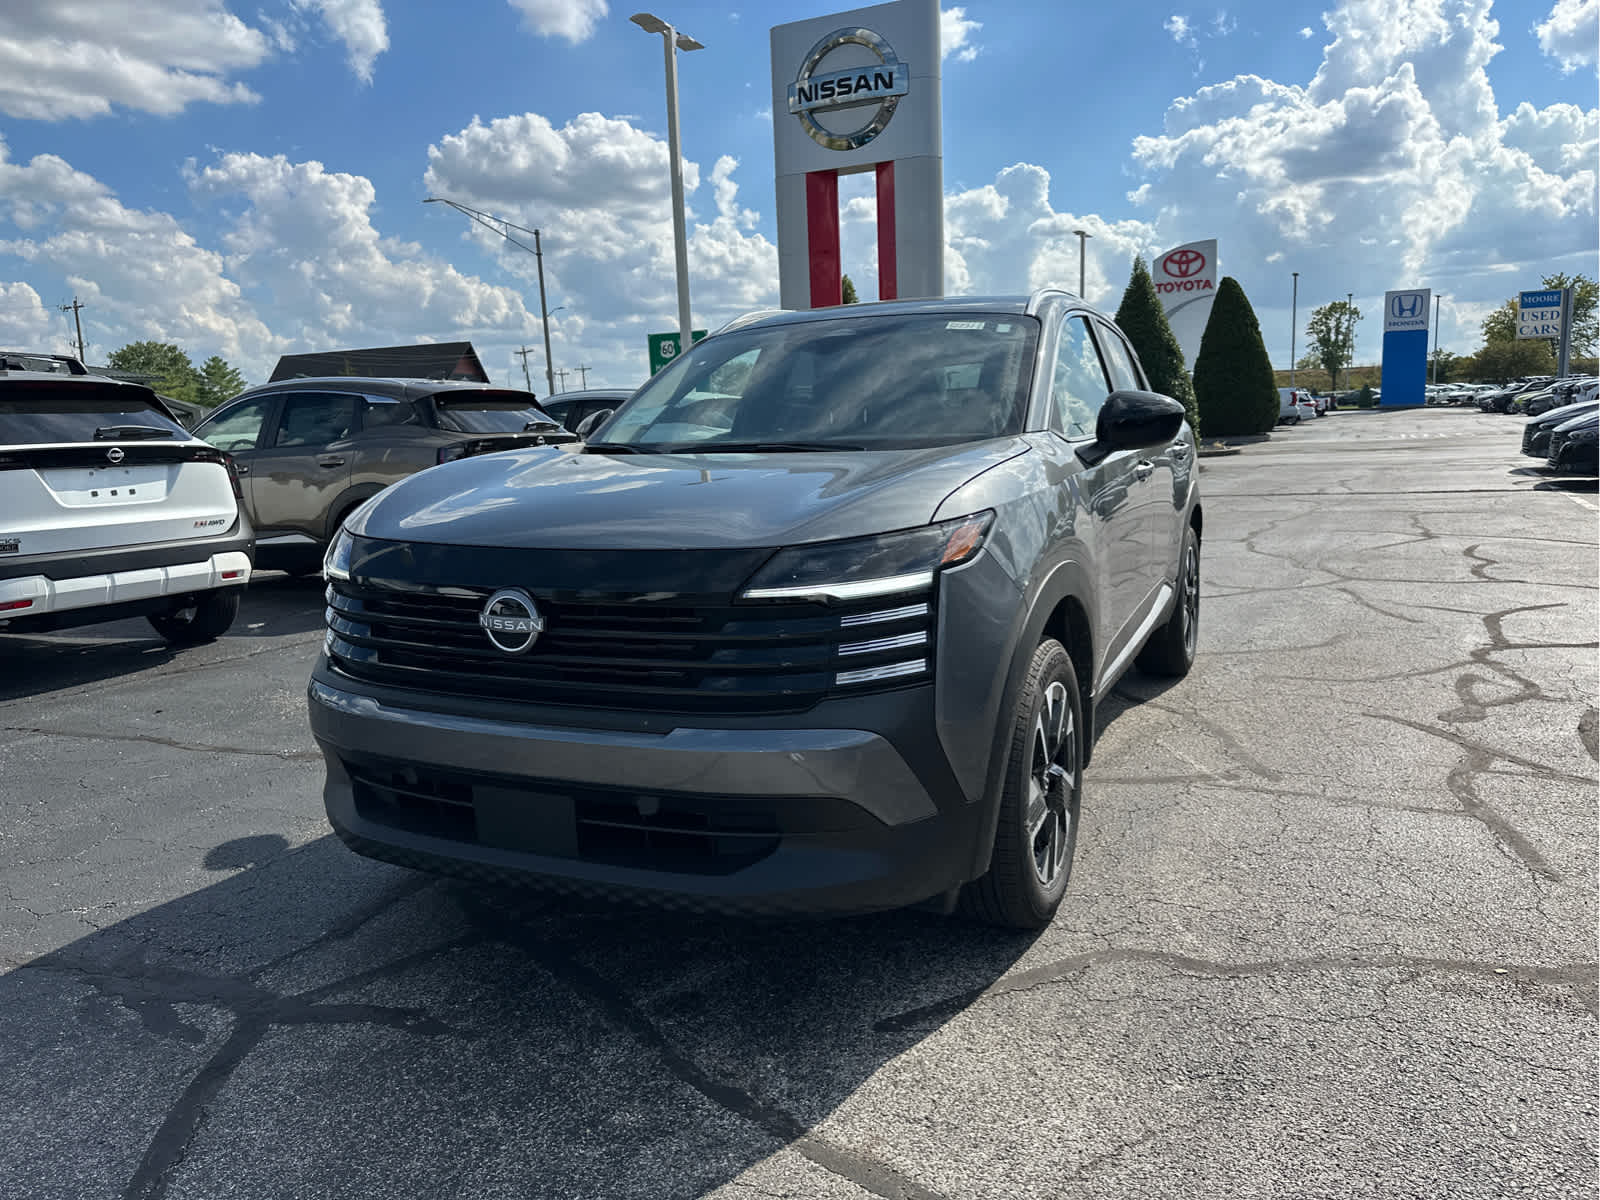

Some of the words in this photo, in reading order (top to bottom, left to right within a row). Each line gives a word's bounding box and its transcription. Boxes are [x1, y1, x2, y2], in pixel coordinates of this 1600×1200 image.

[798, 72, 894, 105] NISSAN
[1155, 279, 1213, 294] TOYOTA
[1522, 294, 1560, 304] MOORE
[1521, 310, 1560, 321] USED
[1520, 324, 1559, 335] CARS
[662, 343, 674, 355] 60
[480, 616, 542, 630] NISSAN
